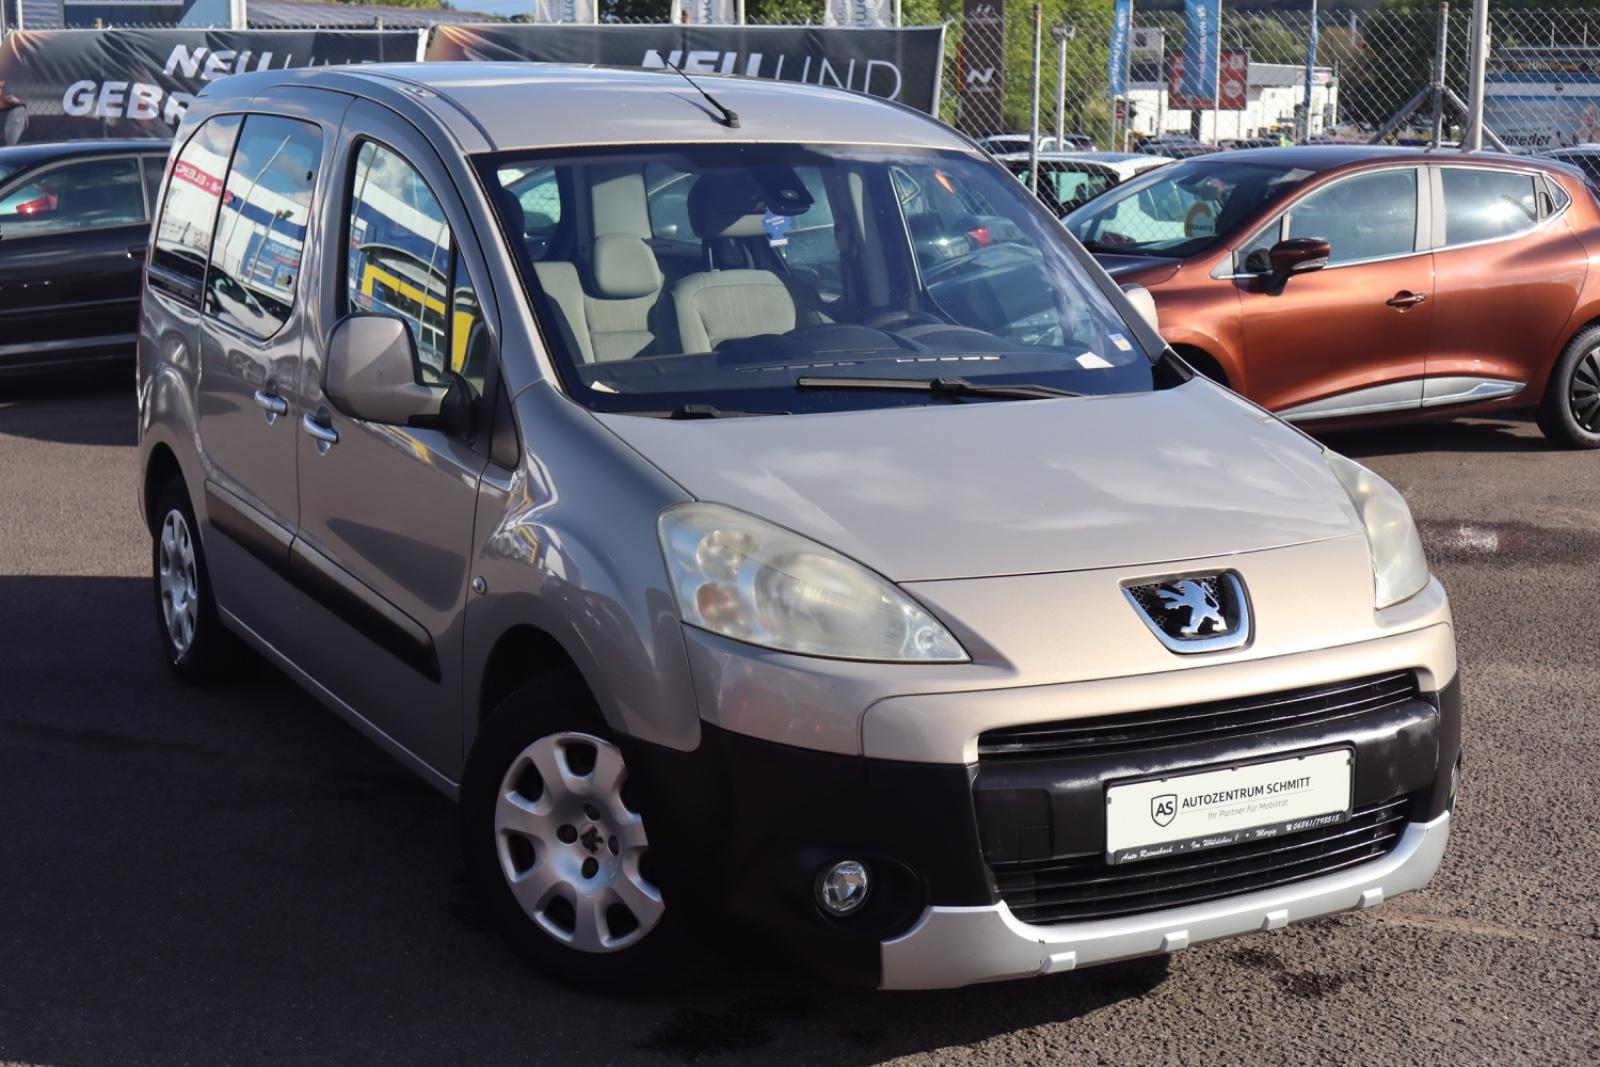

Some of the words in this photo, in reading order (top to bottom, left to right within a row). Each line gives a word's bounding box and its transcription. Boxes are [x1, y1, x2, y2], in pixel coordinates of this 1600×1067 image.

[1182, 785, 1264, 809] AUTOZENTRUM
[1266, 776, 1311, 794] SCHMITT
[1155, 801, 1174, 817] AS
[1218, 808, 1245, 819] Partner
[1259, 798, 1289, 811] Mobilität
